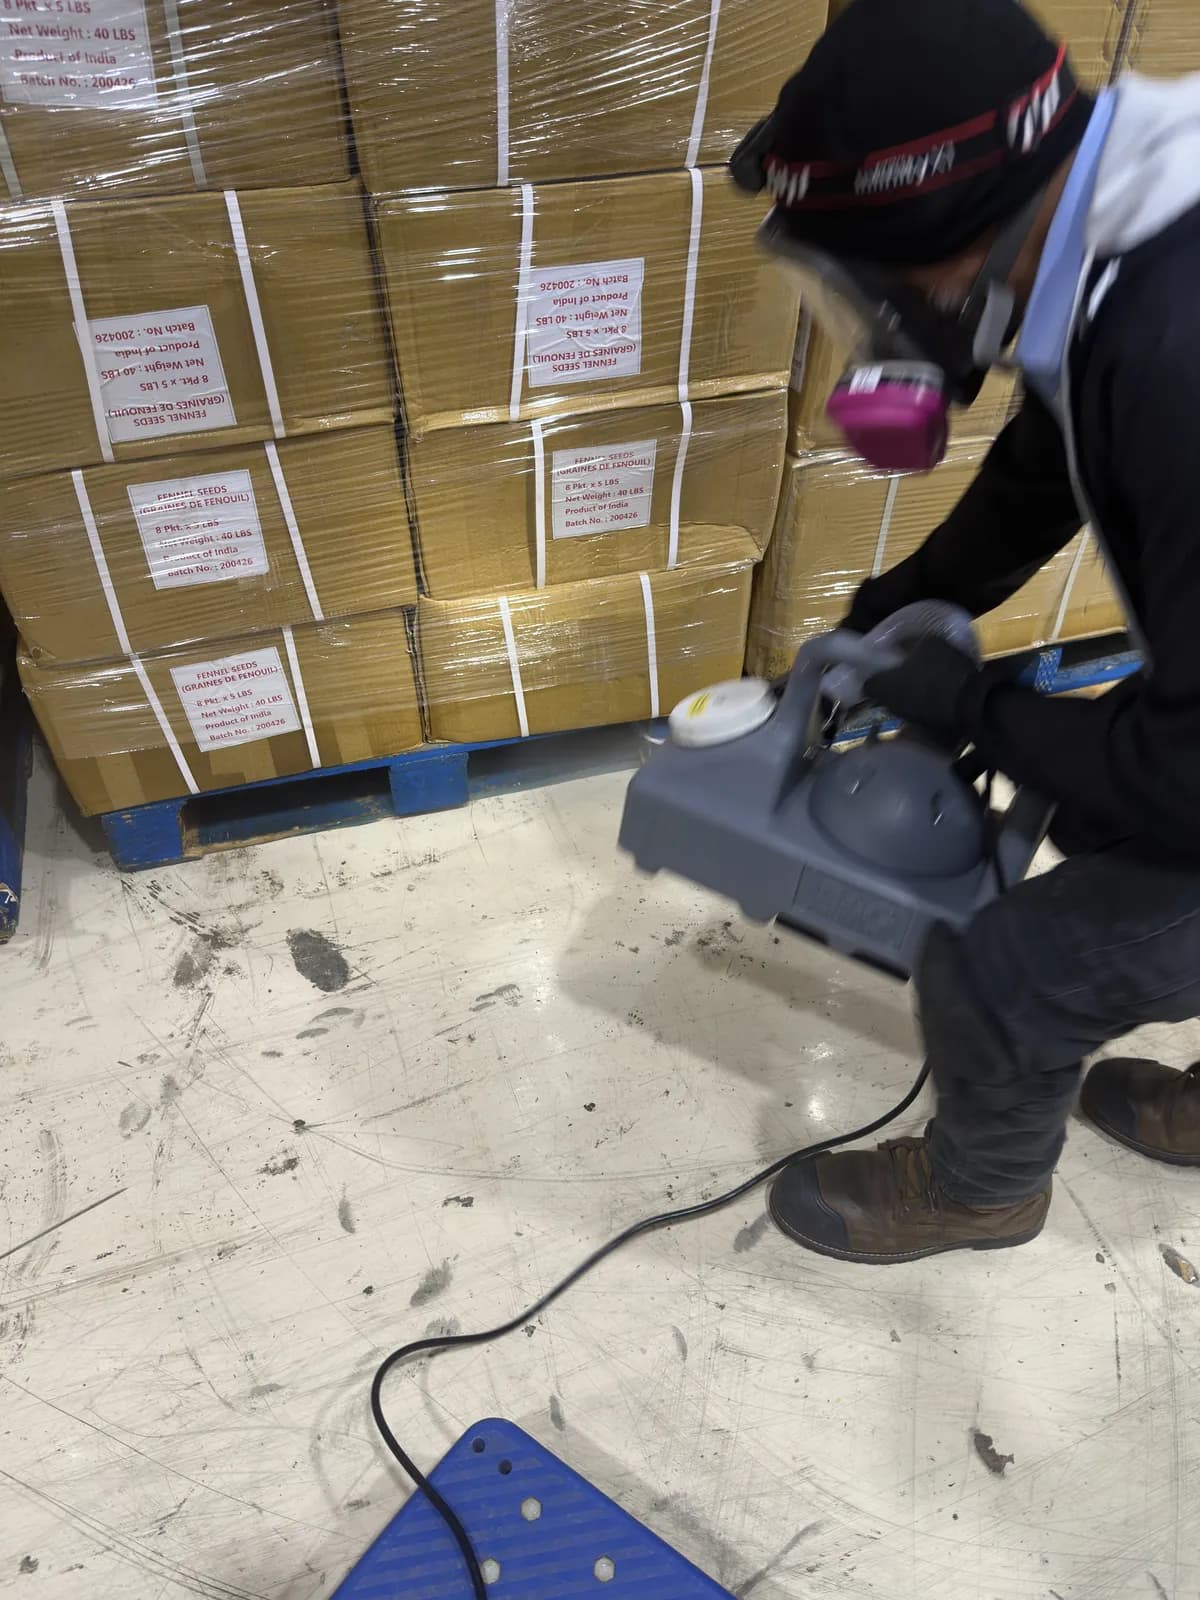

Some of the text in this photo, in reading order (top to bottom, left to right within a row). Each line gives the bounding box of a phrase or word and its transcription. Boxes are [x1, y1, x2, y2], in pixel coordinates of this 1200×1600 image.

[16, 0, 40, 12] Pkt
[56, 1, 63, 12] 5
[68, 2, 91, 13] LBS
[8, 23, 33, 36] Net
[36, 24, 84, 41] Weight
[94, 28, 109, 40] 40
[114, 29, 136, 41] LBS
[69, 50, 81, 62] of
[86, 52, 117, 64] India
[21, 75, 55, 86] Batch
[59, 77, 81, 88] No.
[603, 275, 628, 283] Batch
[540, 281, 574, 291] 200426
[553, 292, 627, 307] Product of India
[576, 311, 608, 321] Weight
[611, 309, 627, 317] Net
[536, 317, 552, 326] LBS
[556, 315, 567, 323] 40
[144, 326, 162, 335] No.
[166, 322, 195, 334] Batch
[96, 330, 135, 343] 200426
[567, 330, 583, 338] LBS
[115, 340, 199, 358] Product of India
[593, 344, 636, 357] (GRAINES
[185, 358, 204, 367] Net
[533, 352, 575, 363] FENOUIL)
[144, 361, 183, 372] Weight
[553, 358, 616, 372] FENNEL SEEDS
[101, 371, 120, 379] LBS
[124, 368, 135, 376] 40
[162, 380, 168, 388] 5
[179, 376, 199, 384] Pkt.
[140, 383, 158, 391] LBS
[108, 395, 225, 417] (GRAINES DE FENOUIL)
[134, 410, 206, 426] FENNEL SEEDS
[608, 452, 634, 460] SEEDS
[613, 459, 650, 468] FENOUIL)
[198, 485, 227, 495] SEEDS
[189, 501, 202, 509] DE
[205, 494, 249, 506] FENOUIL)
[582, 492, 611, 500] Weight
[566, 506, 596, 515] Product
[566, 519, 587, 527] Batch
[610, 512, 638, 521] 200426
[235, 529, 252, 537] LBS
[203, 549, 212, 558] of
[215, 546, 238, 556] India
[220, 558, 253, 569] 200426
[197, 661, 258, 680] FENNEL SEEDS
[182, 667, 278, 693] (GRAINES DE FENOUIL)
[238, 689, 253, 697] LBS
[201, 711, 216, 719] Net
[218, 704, 249, 714] Weight
[268, 695, 282, 703] LBS
[205, 718, 237, 730] Product
[251, 711, 271, 720] India
[209, 731, 232, 741] Batch
[256, 719, 285, 730] 200426
